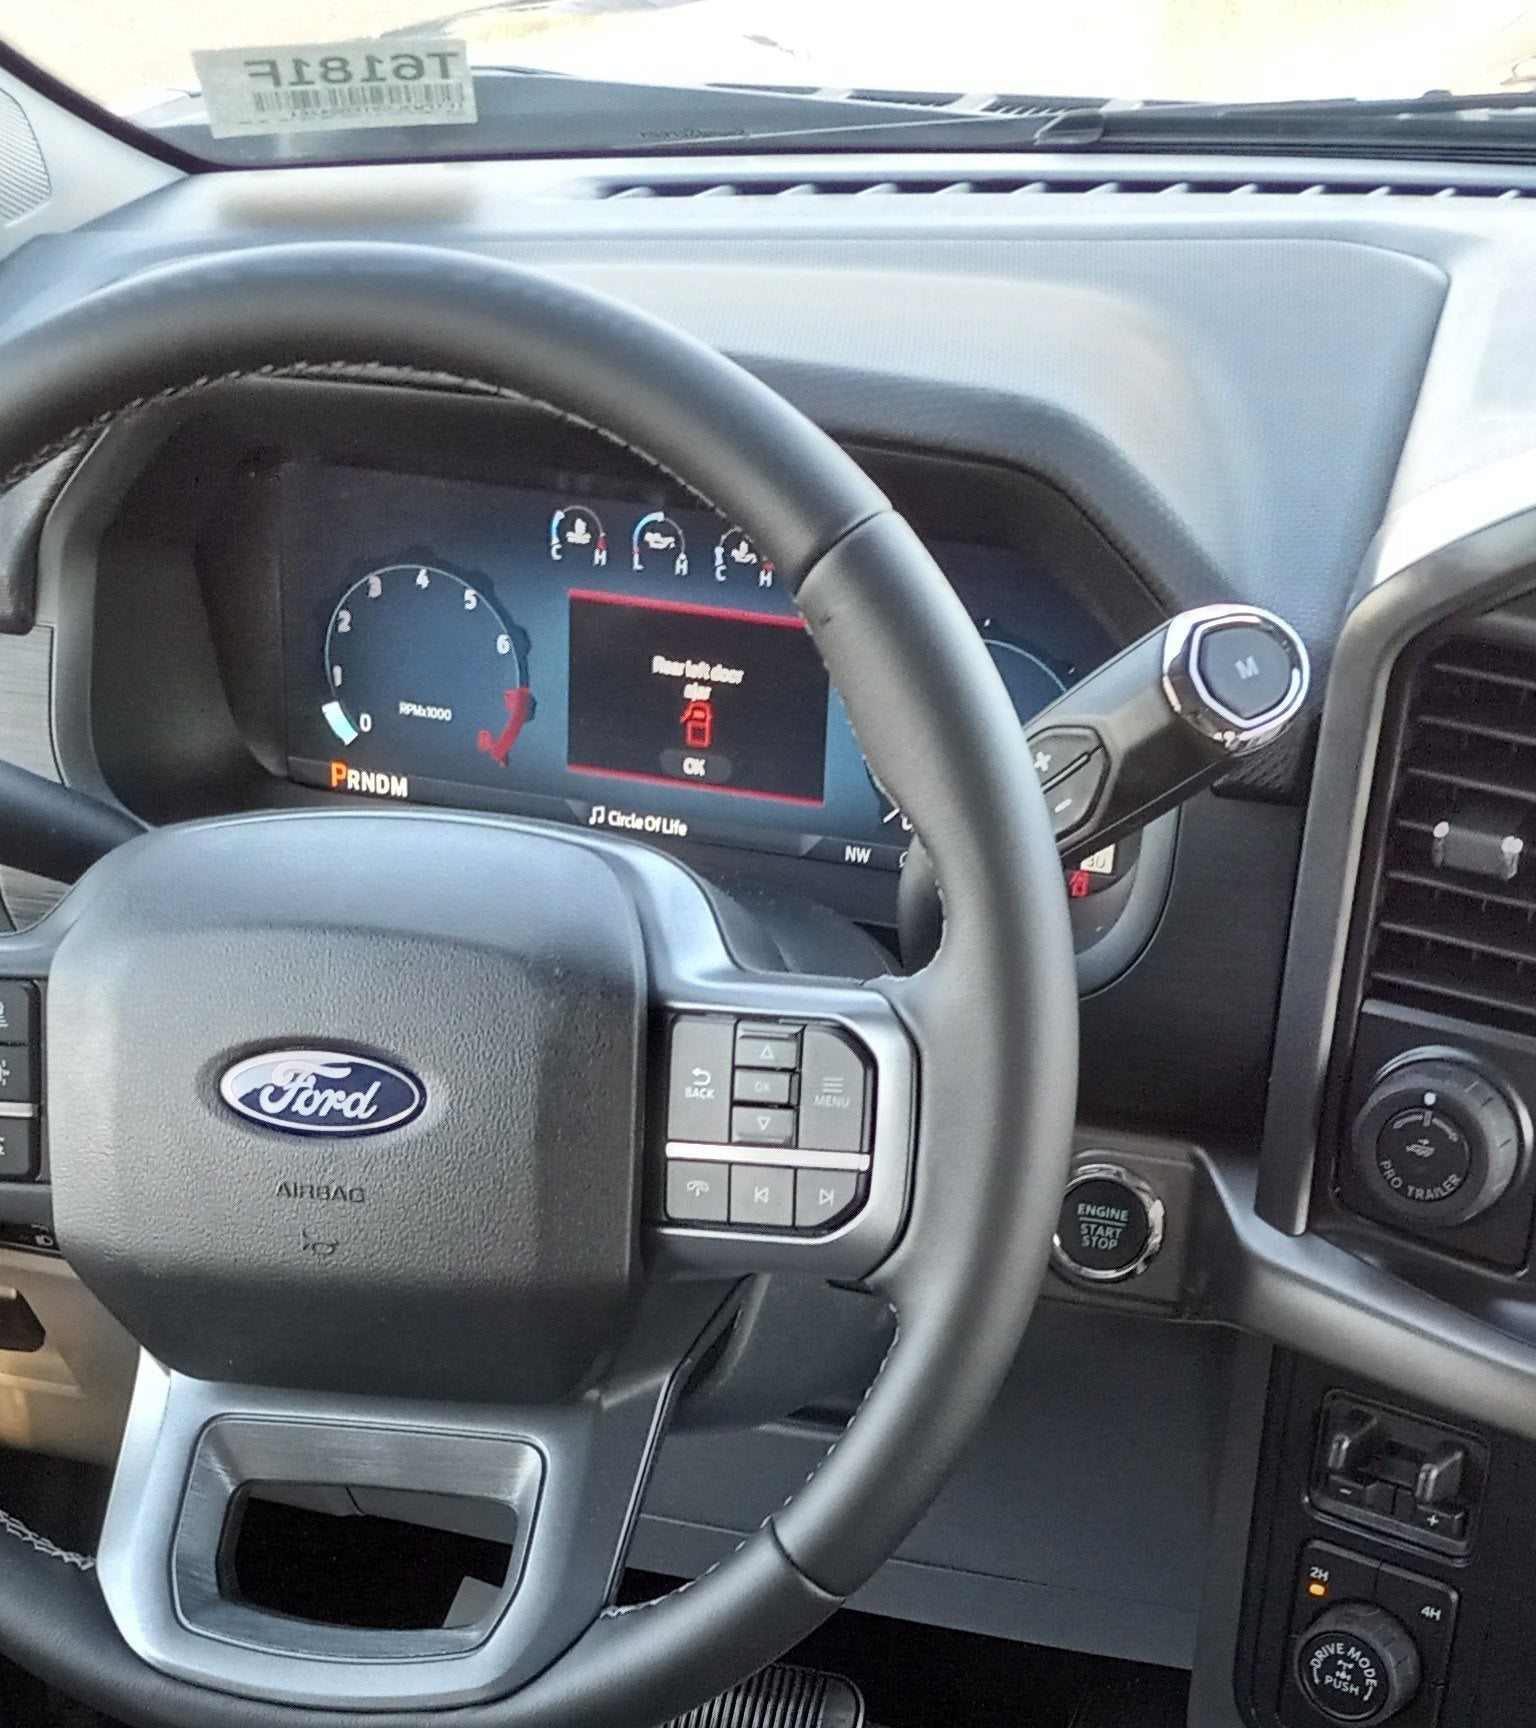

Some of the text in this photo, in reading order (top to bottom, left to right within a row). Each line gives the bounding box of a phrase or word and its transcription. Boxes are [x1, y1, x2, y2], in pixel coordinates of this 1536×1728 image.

[368, 574, 382, 598] 3
[415, 568, 430, 589] 4
[464, 589, 478, 610] 5
[337, 609, 351, 633] 2
[497, 634, 510, 654] 6
[333, 665, 342, 687] 1
[683, 757, 705, 776] OK
[608, 810, 688, 837] Circle Of Life
[845, 845, 871, 863] NW
[259, 1060, 382, 1120] Ford
[684, 1086, 715, 1100] BACK
[813, 1094, 850, 1109] MENU
[1379, 1159, 1463, 1201] PRO TRAILER
[275, 1181, 365, 1203] AIRBAG
[1076, 1202, 1129, 1223] ENGINE
[1079, 1222, 1123, 1242] START
[1081, 1233, 1119, 1251] STOP
[1309, 1565, 1329, 1582] 2H
[1420, 1604, 1441, 1622] 4H
[1309, 1642, 1378, 1688] DRIVE MODE
[1324, 1674, 1361, 1696] PUSH
